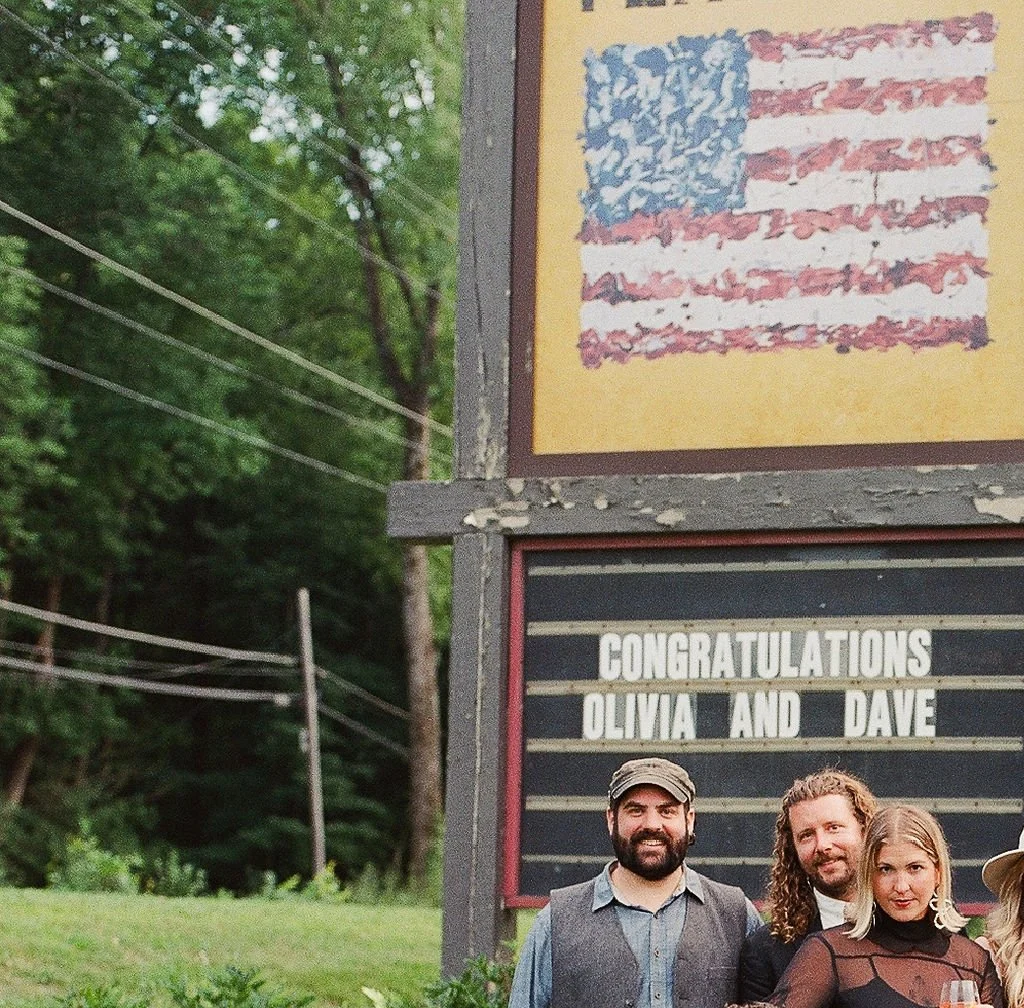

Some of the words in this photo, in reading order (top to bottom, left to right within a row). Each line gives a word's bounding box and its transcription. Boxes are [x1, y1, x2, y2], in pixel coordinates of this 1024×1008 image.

[599, 629, 932, 682] CONGRATULATIONS
[582, 691, 697, 741] OLIVIA
[729, 690, 801, 739] AND
[844, 688, 936, 738] DAVE
